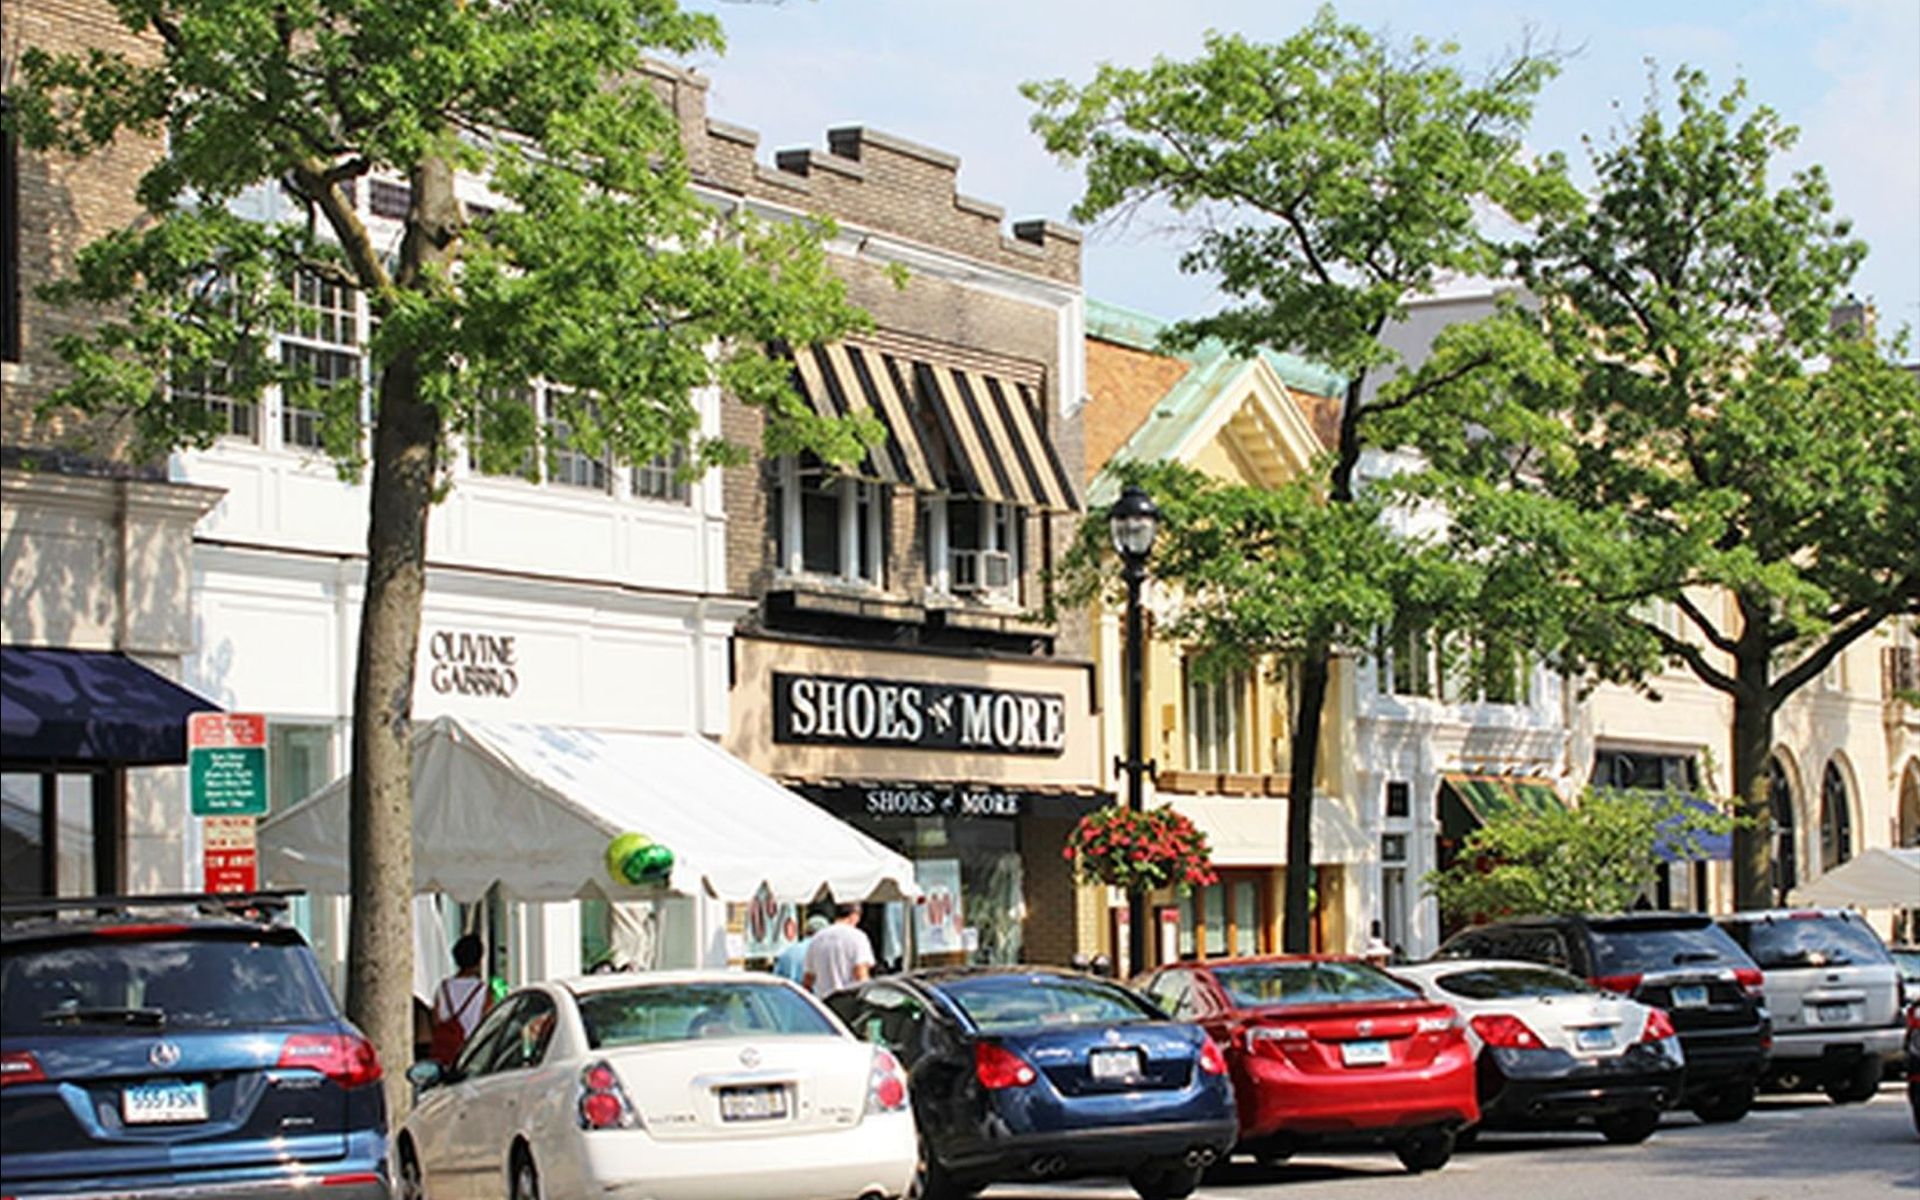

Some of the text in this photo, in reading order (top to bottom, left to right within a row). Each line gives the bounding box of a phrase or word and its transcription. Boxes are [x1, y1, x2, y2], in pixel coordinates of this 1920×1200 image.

[430, 631, 518, 665] OLIVINE
[431, 663, 519, 698] GABBRO
[791, 679, 923, 741] SHOES
[961, 694, 1065, 748] MORE
[866, 790, 935, 814] SHOES
[961, 792, 1019, 815] MORE
